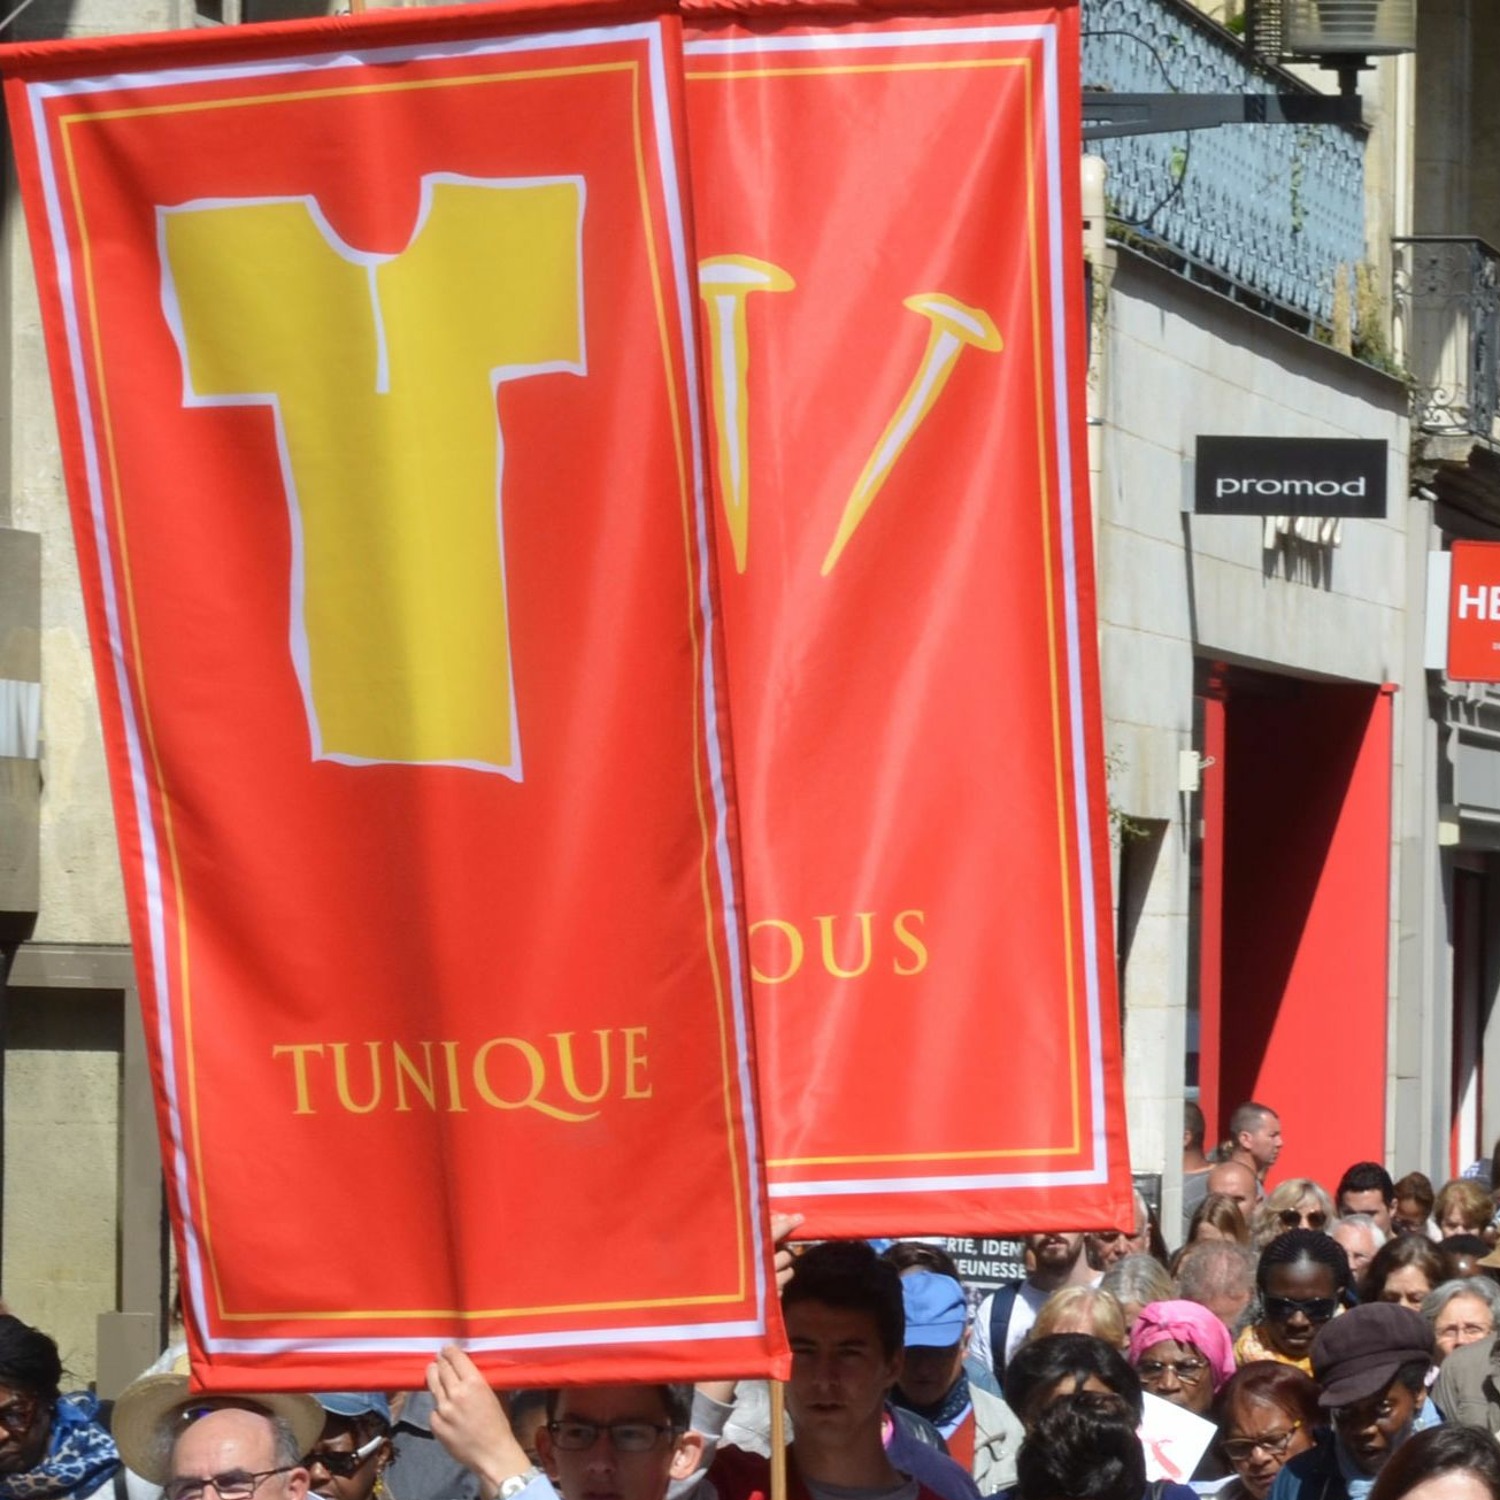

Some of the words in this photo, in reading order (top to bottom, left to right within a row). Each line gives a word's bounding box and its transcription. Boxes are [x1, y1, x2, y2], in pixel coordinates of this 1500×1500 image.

[1216, 476, 1366, 498] promod
[748, 909, 929, 984] OUS
[272, 1026, 653, 1122] TUNIQUE
[944, 1237, 978, 1256] RTE,
[982, 1239, 1025, 1257] IDEN
[955, 1259, 1027, 1279] EUNESSE
